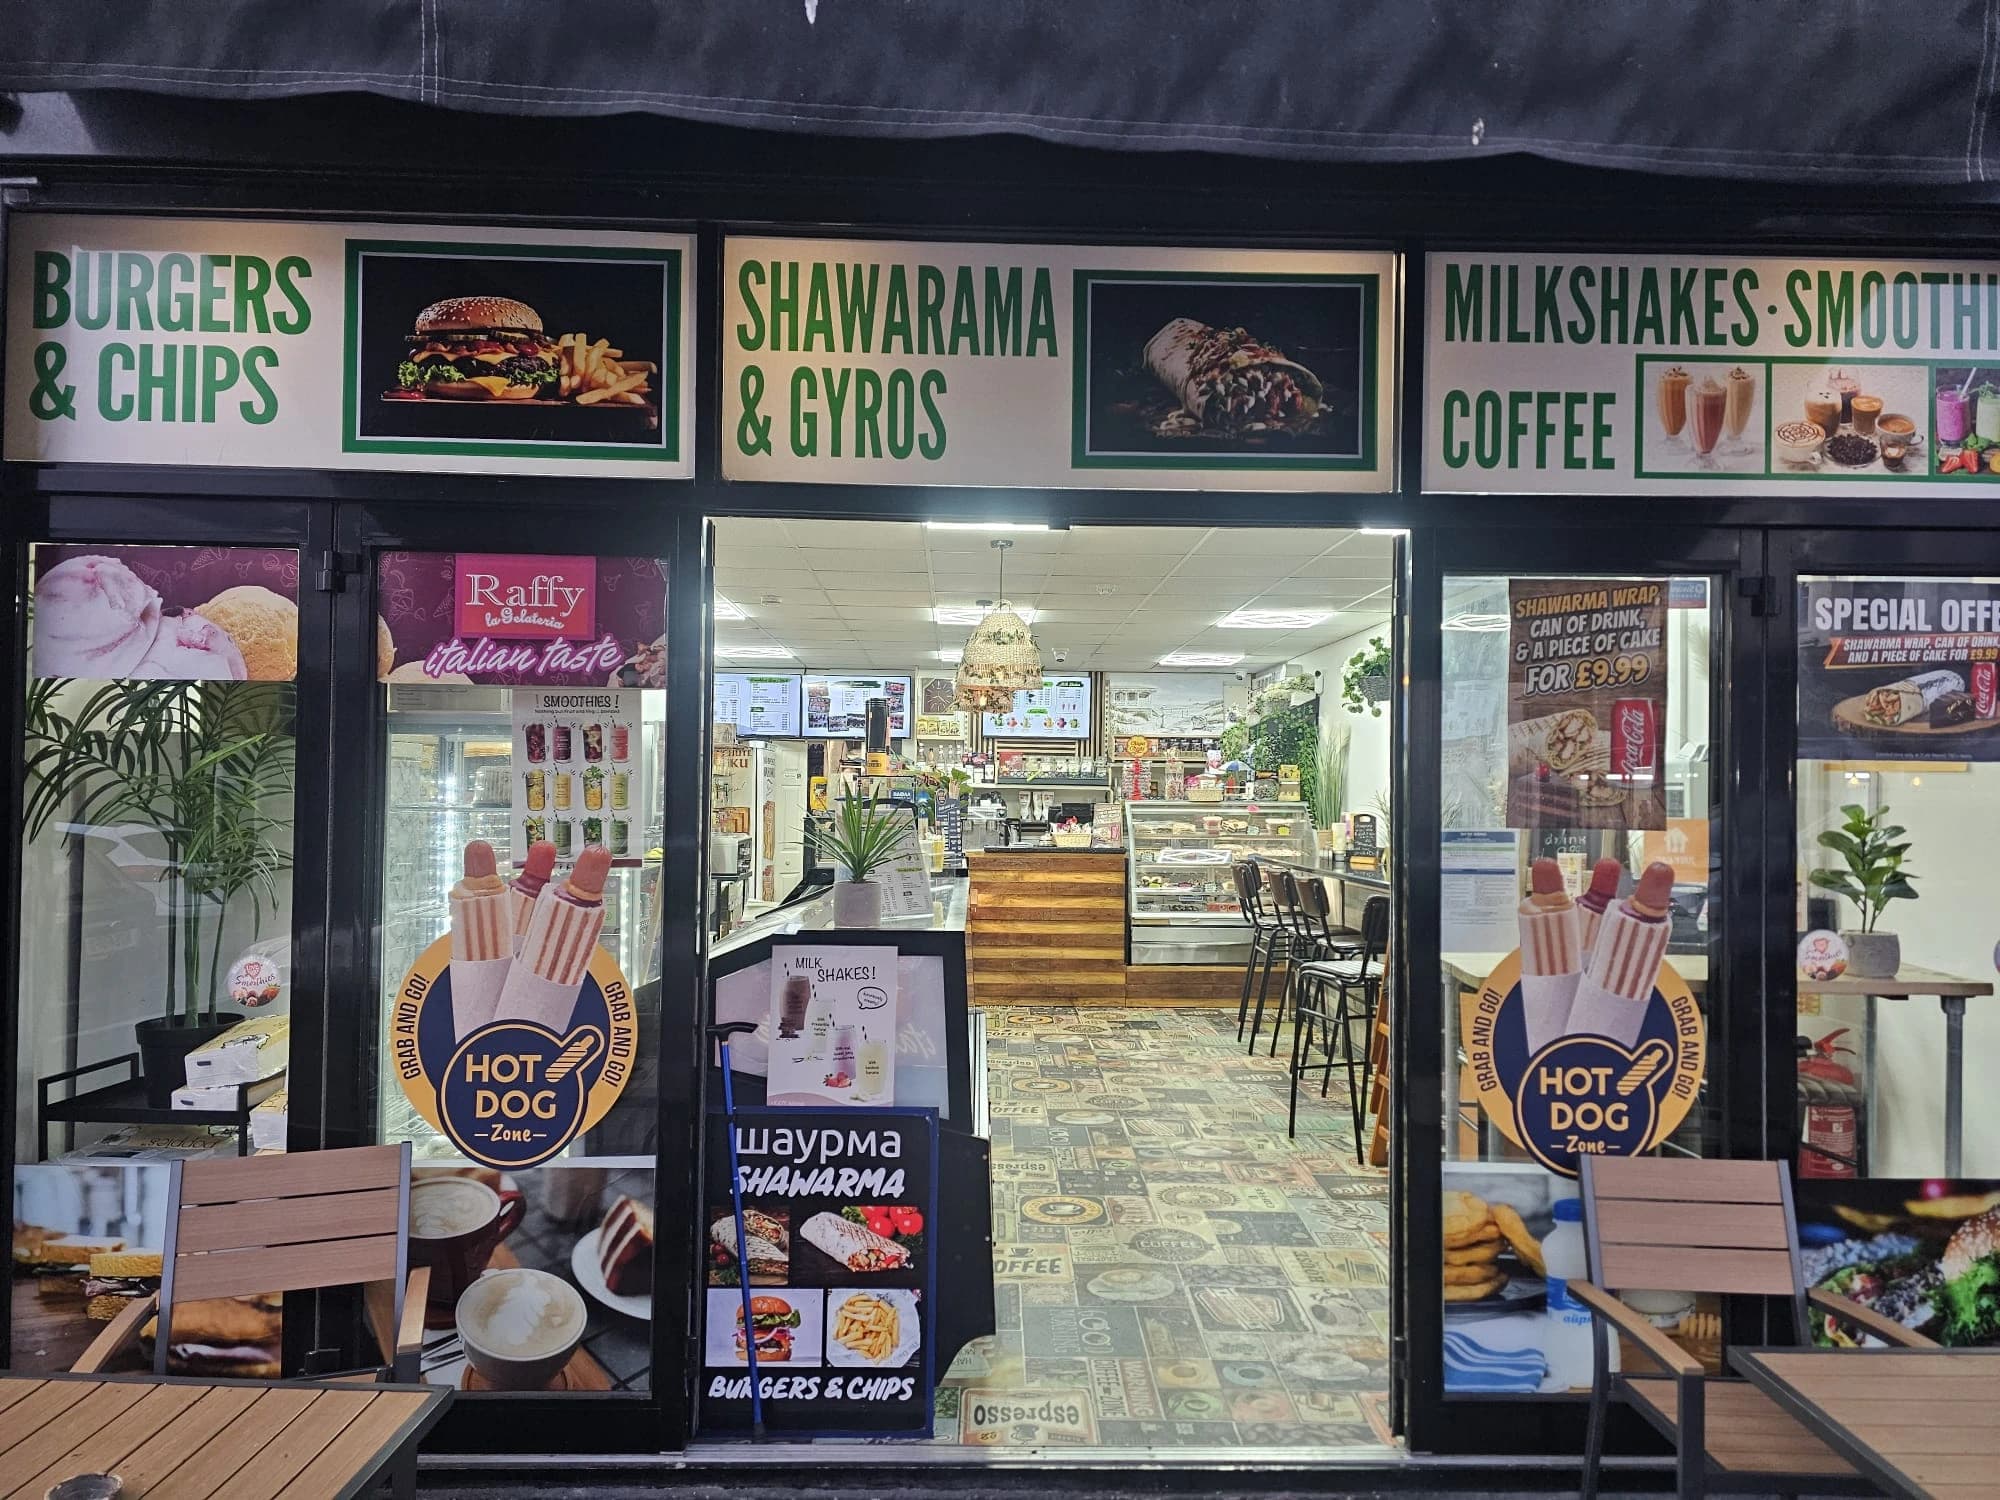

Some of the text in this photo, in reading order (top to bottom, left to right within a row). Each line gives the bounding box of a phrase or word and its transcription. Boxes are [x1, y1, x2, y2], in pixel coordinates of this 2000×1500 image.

[33, 250, 312, 335] BURGERS
[737, 260, 1058, 357] SHAWARAMA
[1445, 264, 1760, 347] MILKSHAKES
[28, 342, 279, 424] & CHIPS
[737, 365, 947, 460] & GYROS
[1443, 390, 1616, 470] COFFEE
[465, 574, 585, 617] Raffy
[1515, 591, 1607, 618] SHAWARMA
[501, 608, 565, 629] Gelateria
[1530, 609, 1645, 639] CAN OF DRINK,
[1815, 597, 1933, 632] SPECIAL
[424, 635, 622, 674] italian taste
[1515, 628, 1661, 661] & A PIECE OF CAKE
[1843, 637, 1901, 651] SHAWARMA
[1934, 637, 1956, 648] CAN
[1957, 636, 1969, 647] OF
[1848, 651, 1868, 664] AND
[1871, 652, 1879, 663] A
[1881, 651, 1907, 663] PIECE
[1909, 651, 1919, 662] OF
[1922, 650, 1947, 662] CAKE
[1949, 649, 1968, 661] FOR
[1526, 655, 1650, 694] FOR £9.99
[543, 695, 611, 708] SMOOTHIES
[795, 957, 823, 969] MILK
[397, 973, 430, 1080] GRAB AND GO!
[601, 981, 631, 1088] GRAB AND GO!
[1472, 988, 1503, 1092] GRAB AND GO!
[1672, 996, 1700, 1101] GRAB AND GO!
[465, 1054, 542, 1082] HOT
[1540, 1067, 1613, 1095] HOT
[475, 1090, 556, 1119] DOG
[1551, 1102, 1629, 1131] DOG
[491, 1124, 532, 1142] Zone
[735, 1127, 901, 1164] шаурма
[1566, 1135, 1606, 1153] Zone
[729, 1166, 905, 1198] SHAWARMA
[708, 1376, 915, 1400] BURGERS & CHIPS
[973, 1400, 1080, 1426] espresso
